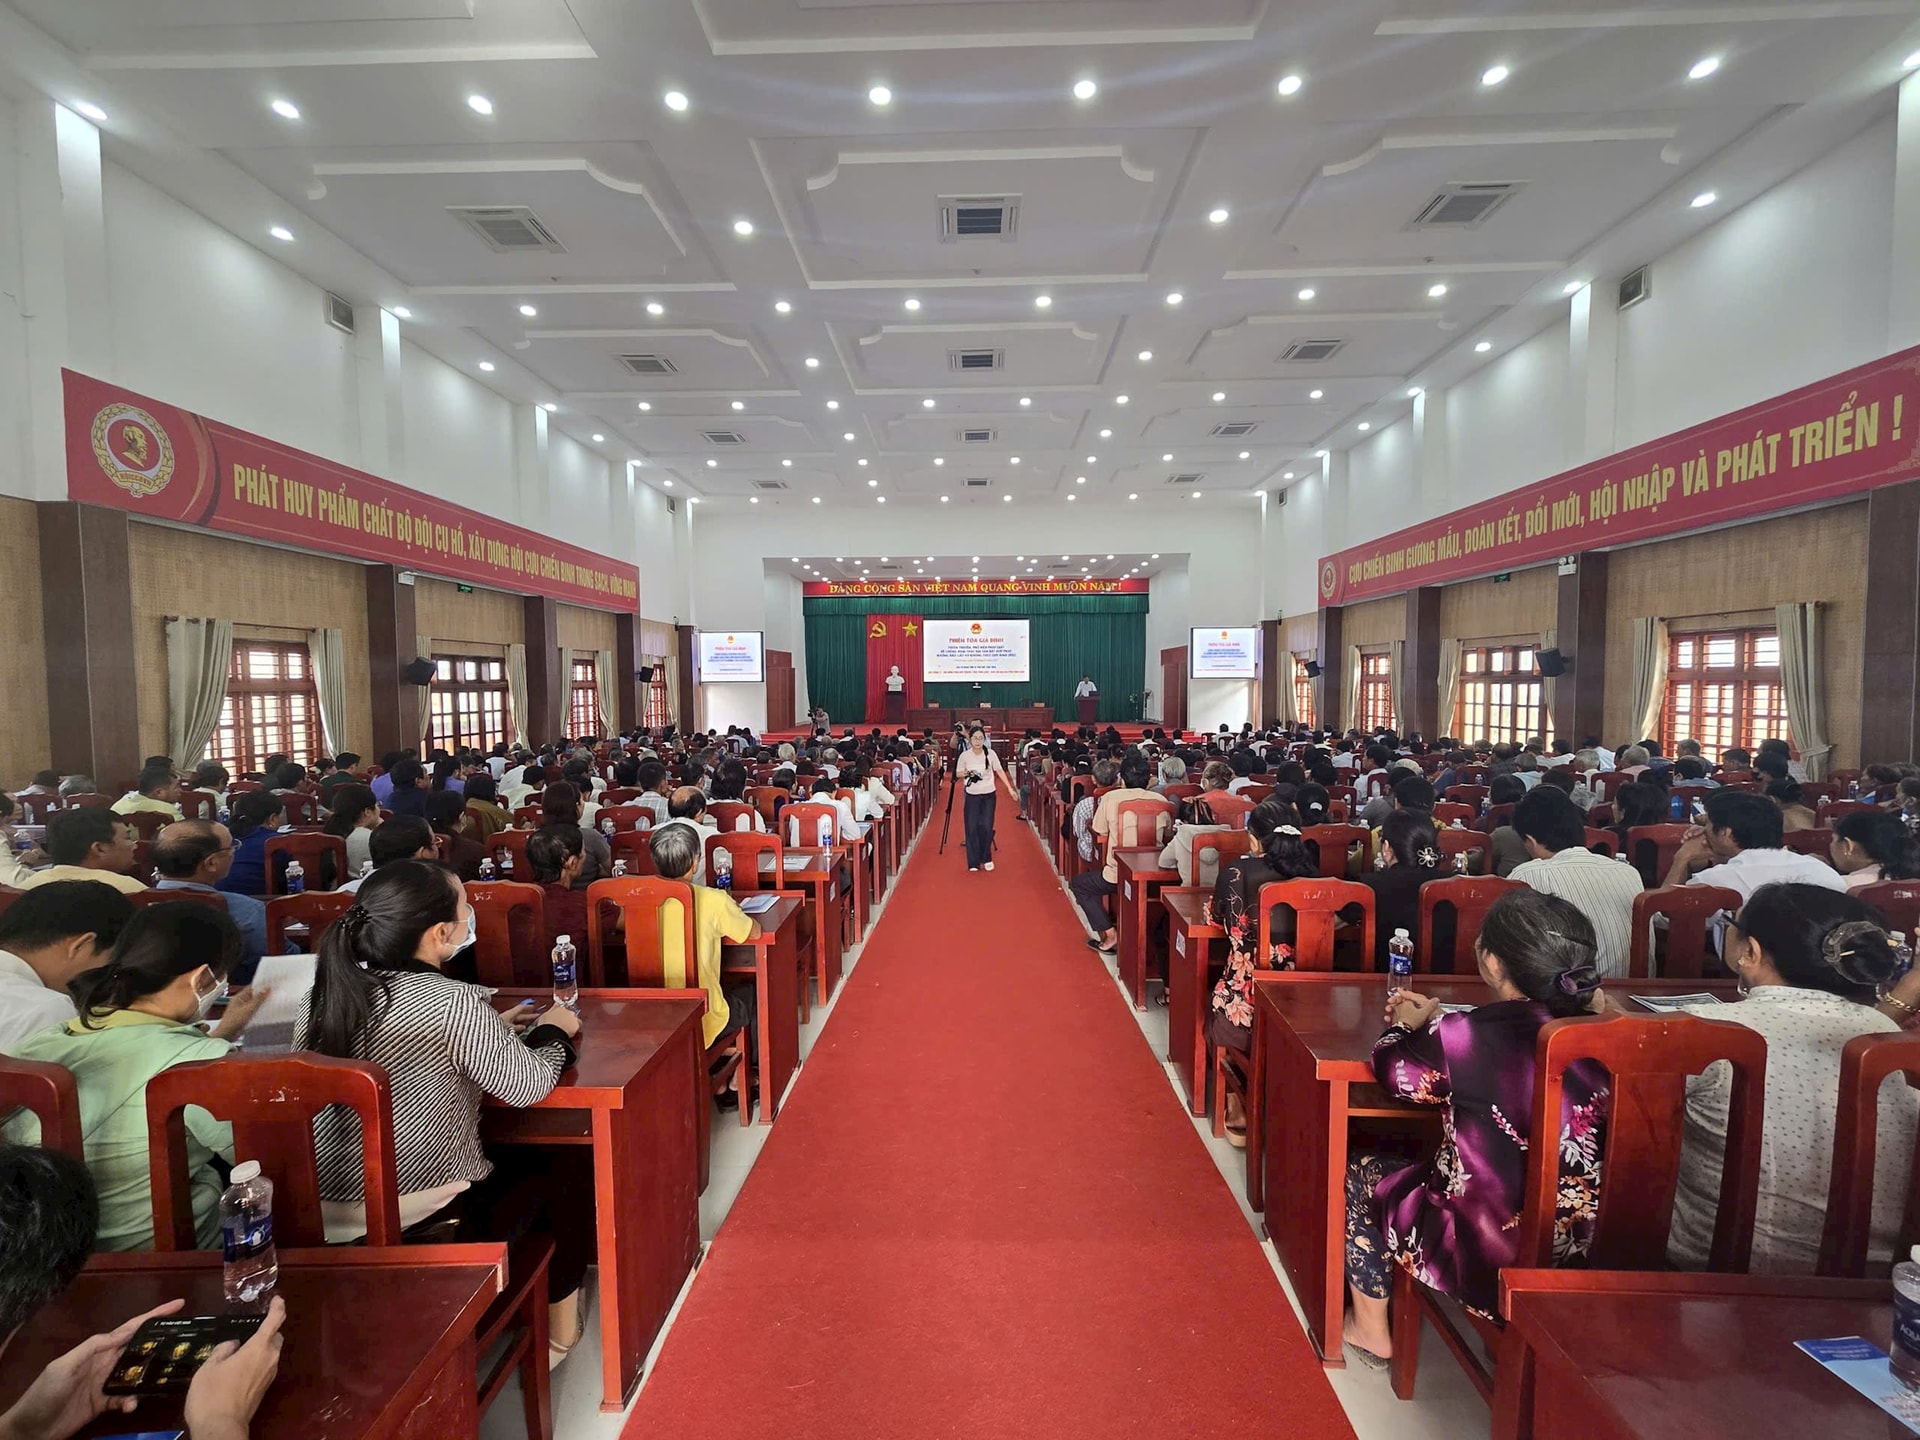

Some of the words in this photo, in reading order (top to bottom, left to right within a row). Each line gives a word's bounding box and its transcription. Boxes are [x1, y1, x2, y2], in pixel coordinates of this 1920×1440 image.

[233, 463, 279, 510] PHÁT
[283, 478, 314, 518] HUY
[318, 482, 360, 529] PHẨM
[363, 497, 393, 539] CHẤT
[396, 509, 413, 550] BỘ
[414, 514, 433, 554] ĐỘI
[435, 523, 449, 559] CỤ
[468, 529, 485, 562] XÂY
[487, 538, 510, 571] DỰNG
[510, 543, 524, 576] HỘI
[524, 550, 539, 579] CỰU
[540, 552, 560, 581] CHIẾN
[560, 561, 576, 585] BINH
[1349, 561, 1362, 588] CỰU
[1363, 550, 1384, 581] CHIẾN
[1385, 549, 1404, 577] BINH
[1406, 540, 1436, 570] GƯƠNG
[1437, 525, 1462, 563] MẪU,
[1464, 519, 1495, 554] ĐOÀN
[1498, 506, 1522, 546] KẾT,
[1525, 494, 1548, 537] ĐỔI
[1551, 489, 1585, 530] MỚI,
[1589, 479, 1618, 525] HỘI
[1622, 463, 1675, 513] NHẬP
[1681, 449, 1709, 497] VÀ
[1716, 429, 1782, 488] PHÁT
[1789, 390, 1880, 468] TRIỂN
[1891, 394, 1904, 441] !
[829, 582, 861, 594] ĐẢNG
[863, 583, 895, 594] CỘNG
[898, 581, 921, 594] SẢN
[924, 582, 950, 594] VIỆT
[952, 583, 977, 593] NAM
[980, 582, 1020, 593] QUANG
[1023, 582, 1050, 592] VINH
[1053, 581, 1087, 592] MUÔN
